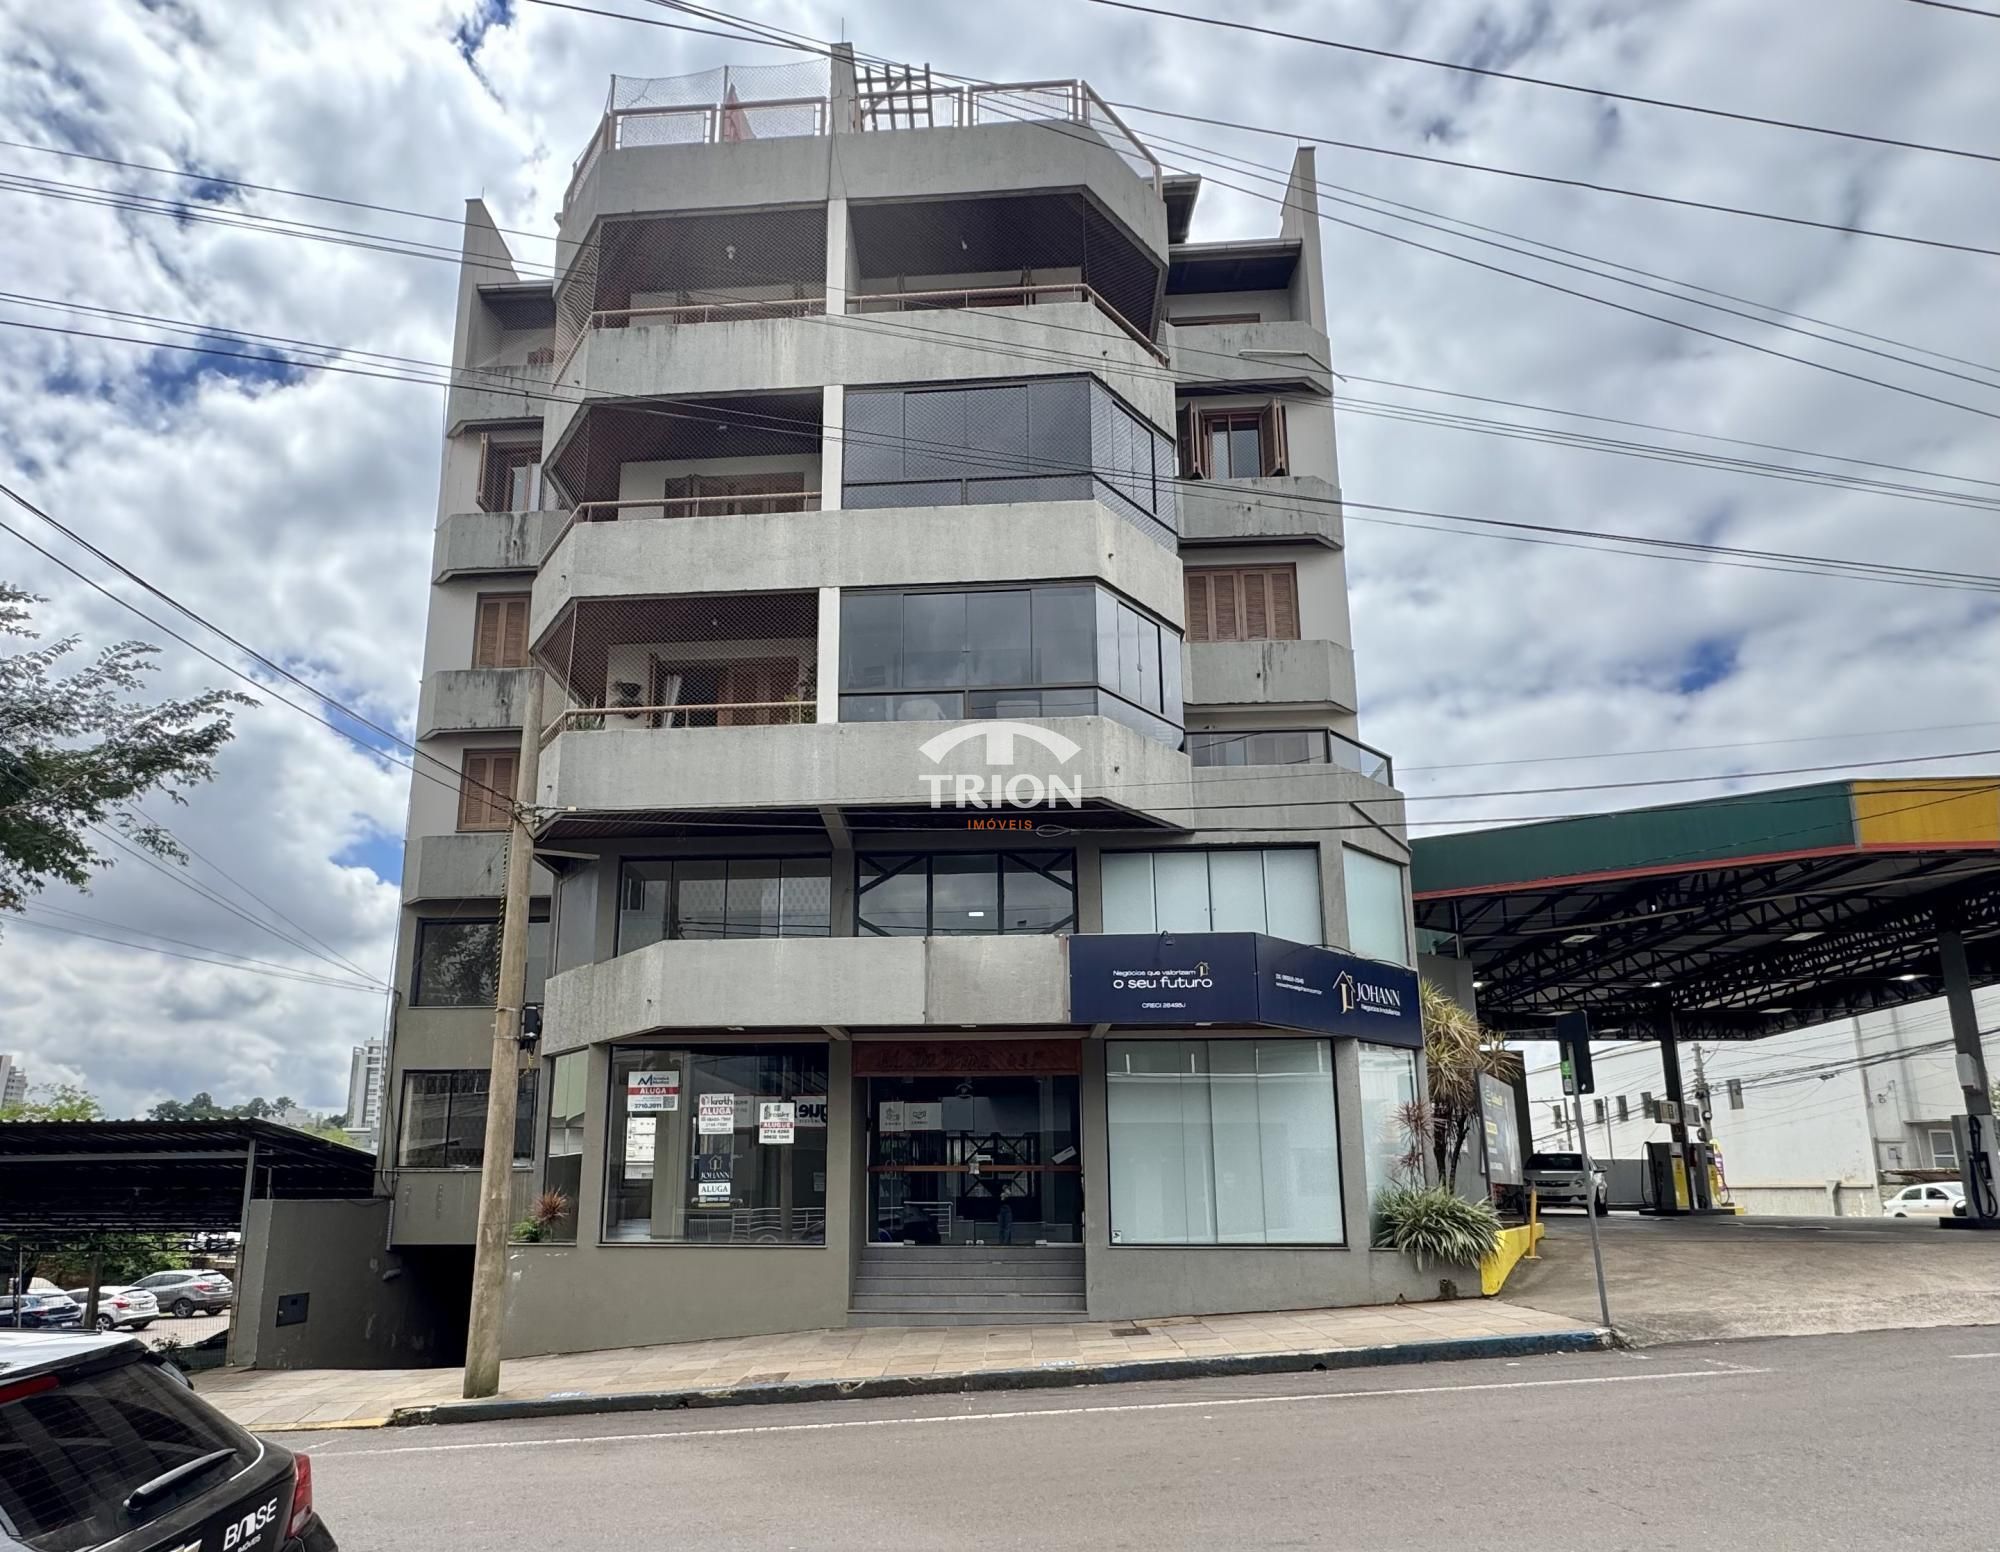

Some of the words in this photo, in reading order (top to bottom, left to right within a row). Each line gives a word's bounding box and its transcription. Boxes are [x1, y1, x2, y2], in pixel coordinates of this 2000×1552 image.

[1113, 979, 1124, 989] o
[1128, 979, 1157, 989] seu
[1160, 976, 1213, 989] futuro
[1356, 982, 1401, 1007] JOHANN
[640, 1087, 667, 1095] ALUGA
[701, 1106, 731, 1115] ALUGA
[700, 1171, 730, 1180] JOHANN
[701, 1185, 729, 1193] ALUGA
